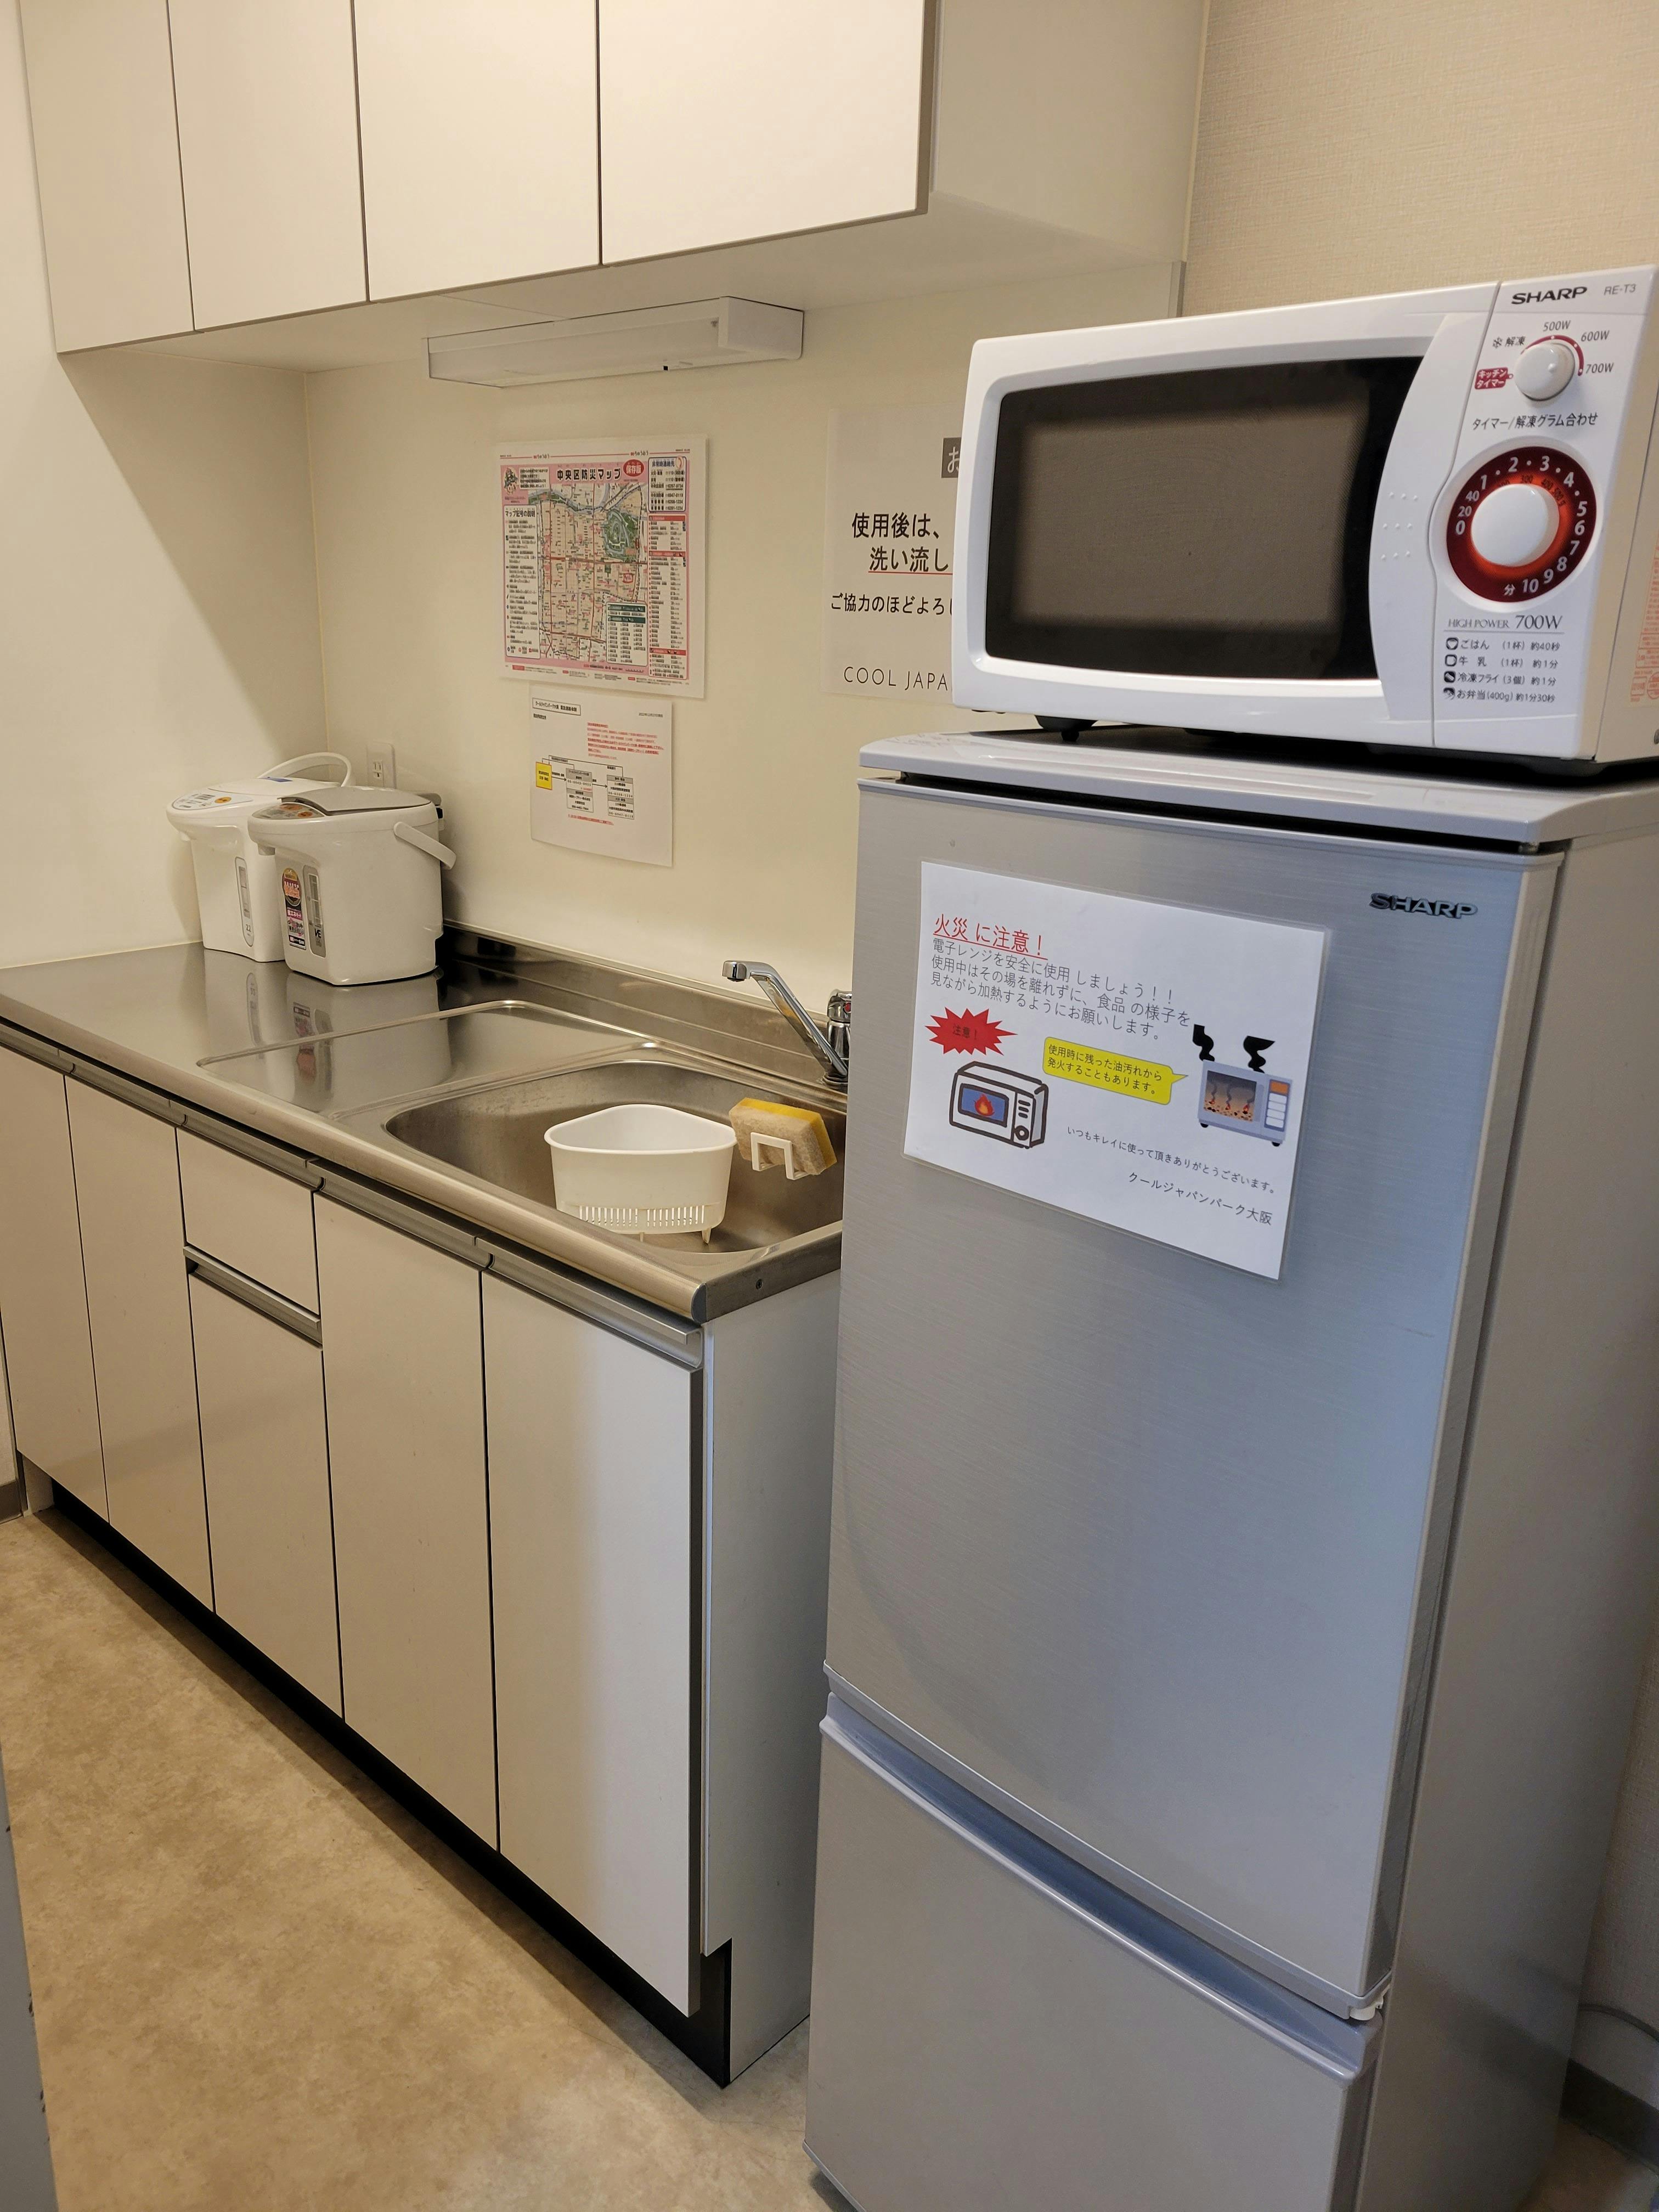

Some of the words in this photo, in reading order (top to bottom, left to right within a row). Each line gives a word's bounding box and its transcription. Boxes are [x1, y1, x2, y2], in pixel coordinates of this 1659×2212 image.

[1511, 286, 1588, 304] SHARP
[1604, 284, 1637, 296] RE-T3
[1543, 320, 1571, 332] 500W
[1505, 336, 1526, 347] 解凍
[1581, 330, 1610, 342] 600W
[1479, 369, 1507, 378] キッチン
[1585, 363, 1614, 374] 700W
[1476, 379, 1504, 388] タイマー
[1508, 457, 1518, 472] 2
[1539, 455, 1550, 471] 3
[557, 468, 621, 481] 中央区防災マップ
[1481, 475, 1487, 489] 1
[1564, 472, 1574, 487] 4
[1465, 490, 1480, 501] 40
[1458, 506, 1472, 517] 20
[1576, 501, 1588, 517] 5
[851, 512, 940, 539] 使用後は、
[1455, 520, 1465, 535] 0
[1575, 520, 1585, 535] 6
[1570, 540, 1580, 555] 7
[869, 546, 949, 572] 洗い流し
[1556, 556, 1567, 571] 8
[1544, 568, 1554, 584] 9
[1503, 584, 1516, 596] 分
[1522, 578, 1539, 593] 10
[1448, 619, 1472, 628] HIGH
[1474, 619, 1509, 629] POWER
[1515, 614, 1562, 629] 700W
[1460, 639, 1489, 650] ごはん
[844, 666, 896, 687] COOL
[905, 670, 952, 691] JAPA
[1457, 672, 1499, 684] 冷凍フライ
[1369, 893, 1478, 919] SHARP
[930, 972, 1158, 1040] 見ながら加熱するようにお願いします。
[1048, 1044, 1162, 1081] 使用時に残った油汚れから
[1047, 1057, 1155, 1094] 発火することもあります。
[1068, 1126, 1274, 1194] いつもキレイに使って頂きありがとうございます。
[1128, 1172, 1273, 1226] クールジャパンパーク大阪
